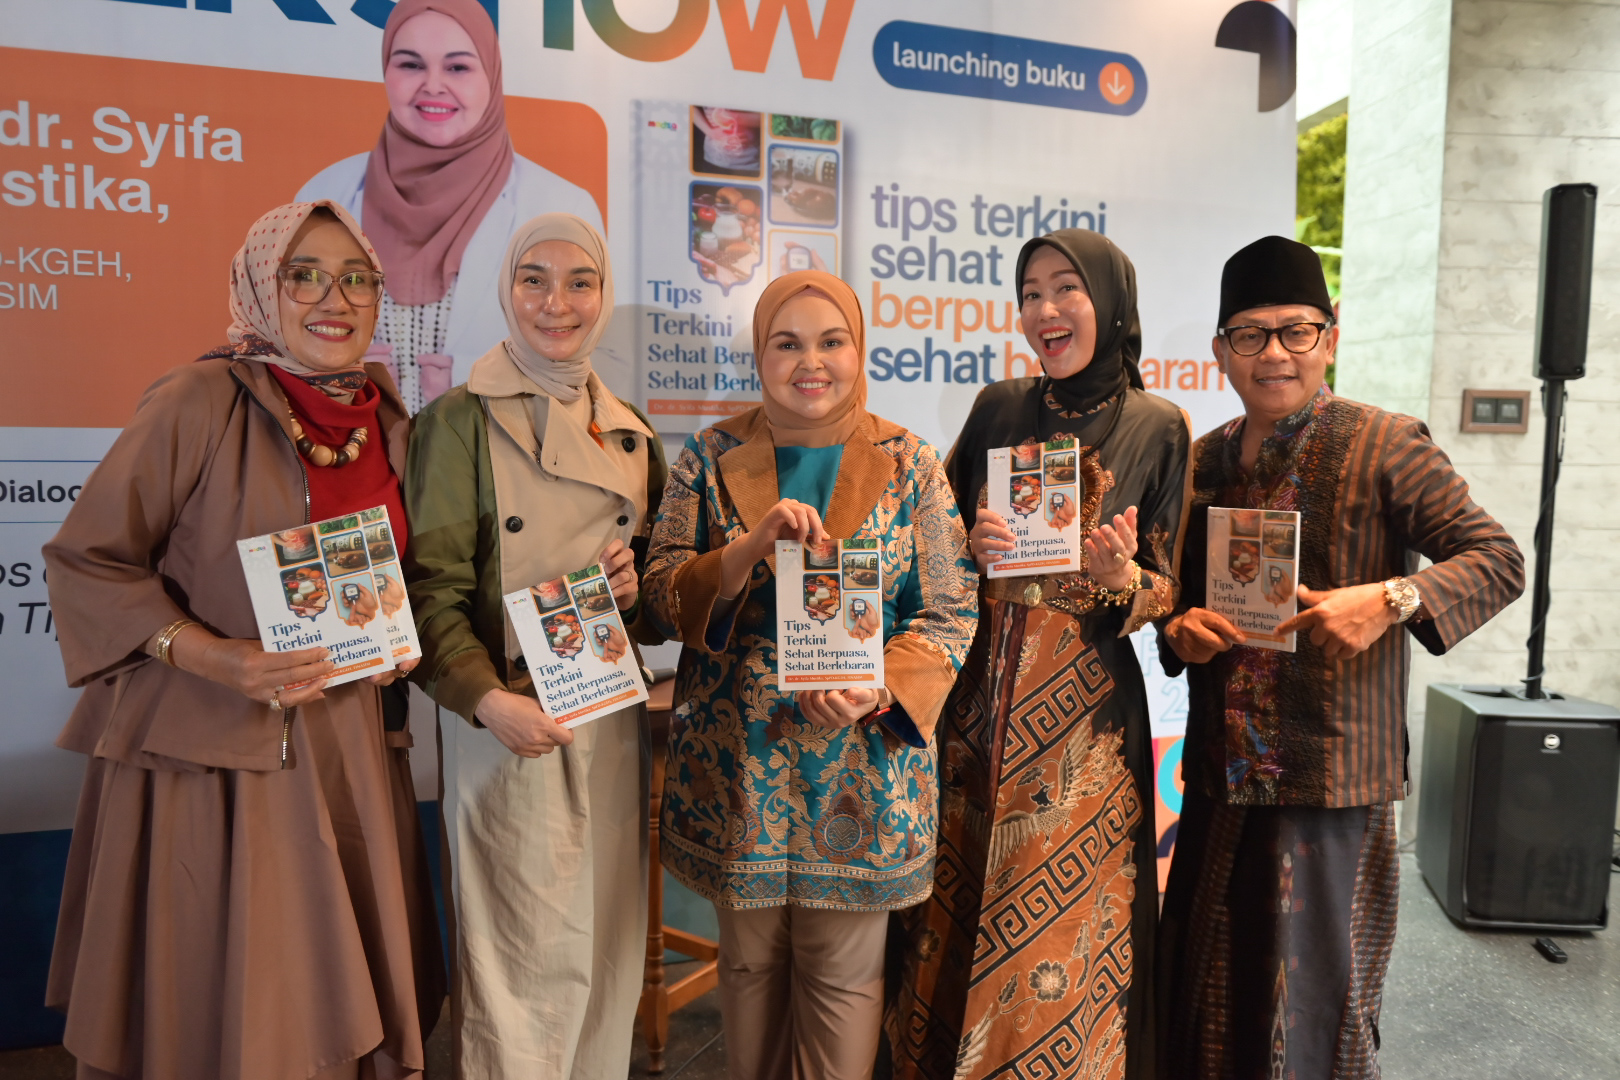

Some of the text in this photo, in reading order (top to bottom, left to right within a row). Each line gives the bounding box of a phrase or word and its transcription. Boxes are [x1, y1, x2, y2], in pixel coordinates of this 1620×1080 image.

[893, 41, 1019, 87] launching
[1026, 59, 1086, 90] buku
[0, 100, 244, 168] dr. Syifa
[871, 183, 1107, 241] tips terkini
[0, 246, 131, 282] -KGEH,
[870, 236, 1004, 286] sehat
[647, 280, 702, 309] Tips
[647, 312, 732, 337] Terkini
[648, 343, 707, 364] Sehat
[868, 337, 996, 384] sehat
[648, 370, 707, 390] Sehat
[1020, 537, 1066, 548] Berpuasa,
[1020, 547, 1071, 559] Berlebaran
[1212, 579, 1234, 591] Tips
[1212, 592, 1246, 605] Terkini
[1238, 608, 1282, 621] Berpuasa,
[268, 623, 302, 637] Tips
[784, 620, 811, 633] Tips
[272, 629, 323, 652] Terkini
[784, 634, 827, 645] Terkini
[785, 649, 869, 659] Sehat Berpuasa,
[536, 662, 564, 677] Tips
[785, 661, 875, 671] Sehat Berlebaran
[541, 668, 583, 690] Terkini
[546, 670, 626, 703] Sehat Berpuasa,
[550, 697, 580, 714] Sehat
[580, 678, 635, 703] Berlebaran
